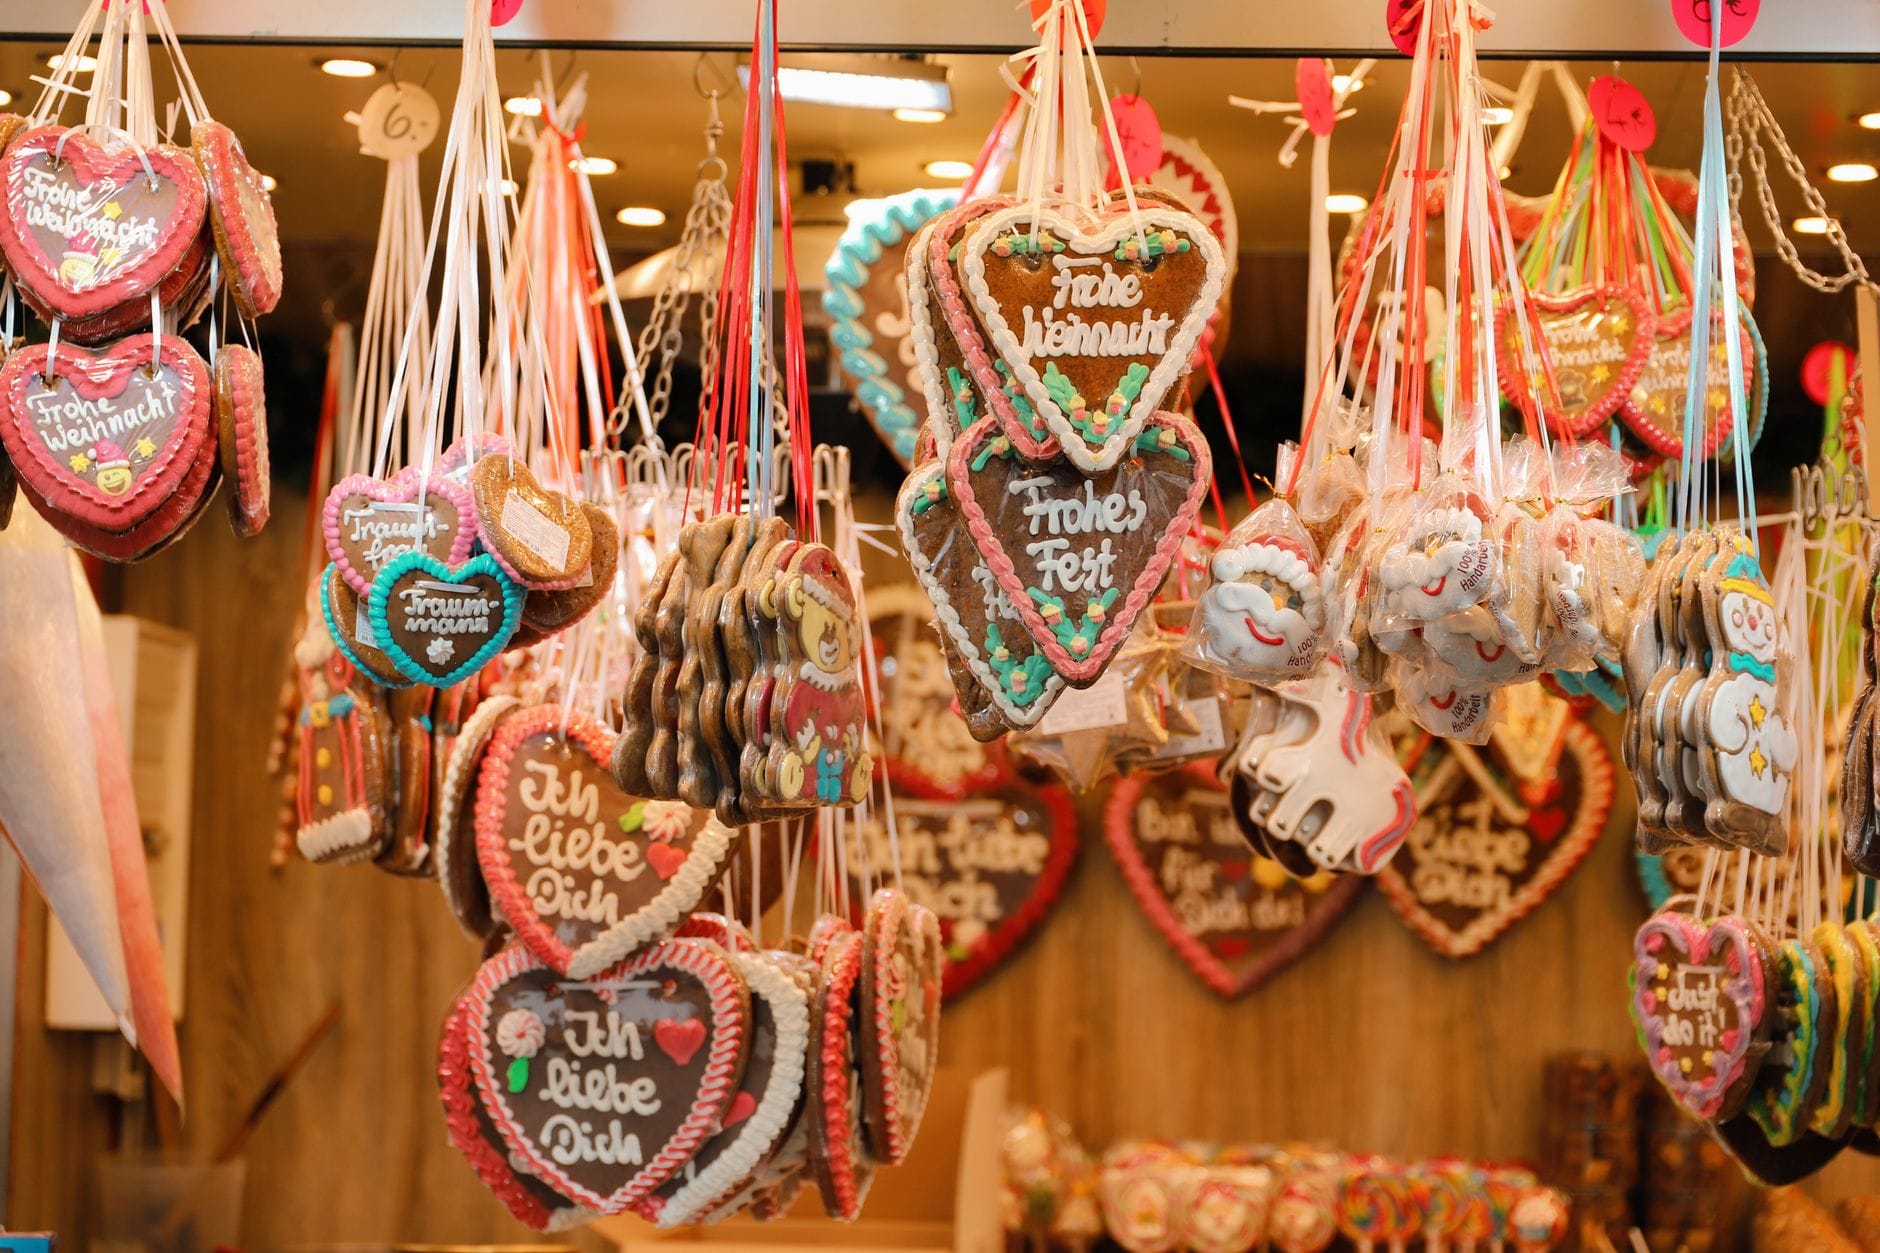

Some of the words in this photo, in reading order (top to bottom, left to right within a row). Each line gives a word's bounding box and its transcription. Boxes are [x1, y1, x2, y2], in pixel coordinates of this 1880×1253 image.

[1051, 253, 1144, 310] Frohe
[25, 391, 118, 425] Frohe
[39, 380, 177, 452] Weihnacht
[1008, 475, 1148, 535] Frohes
[1025, 537, 1118, 592] Fest
[399, 589, 500, 616] Traum-
[404, 616, 490, 635] mann
[1452, 694, 1481, 733] Handarbeit
[519, 758, 600, 825] Ich
[525, 866, 620, 925] Dich
[563, 1009, 645, 1061] Ich
[1662, 1013, 1695, 1047] do
[539, 1113, 644, 1166] Dich
